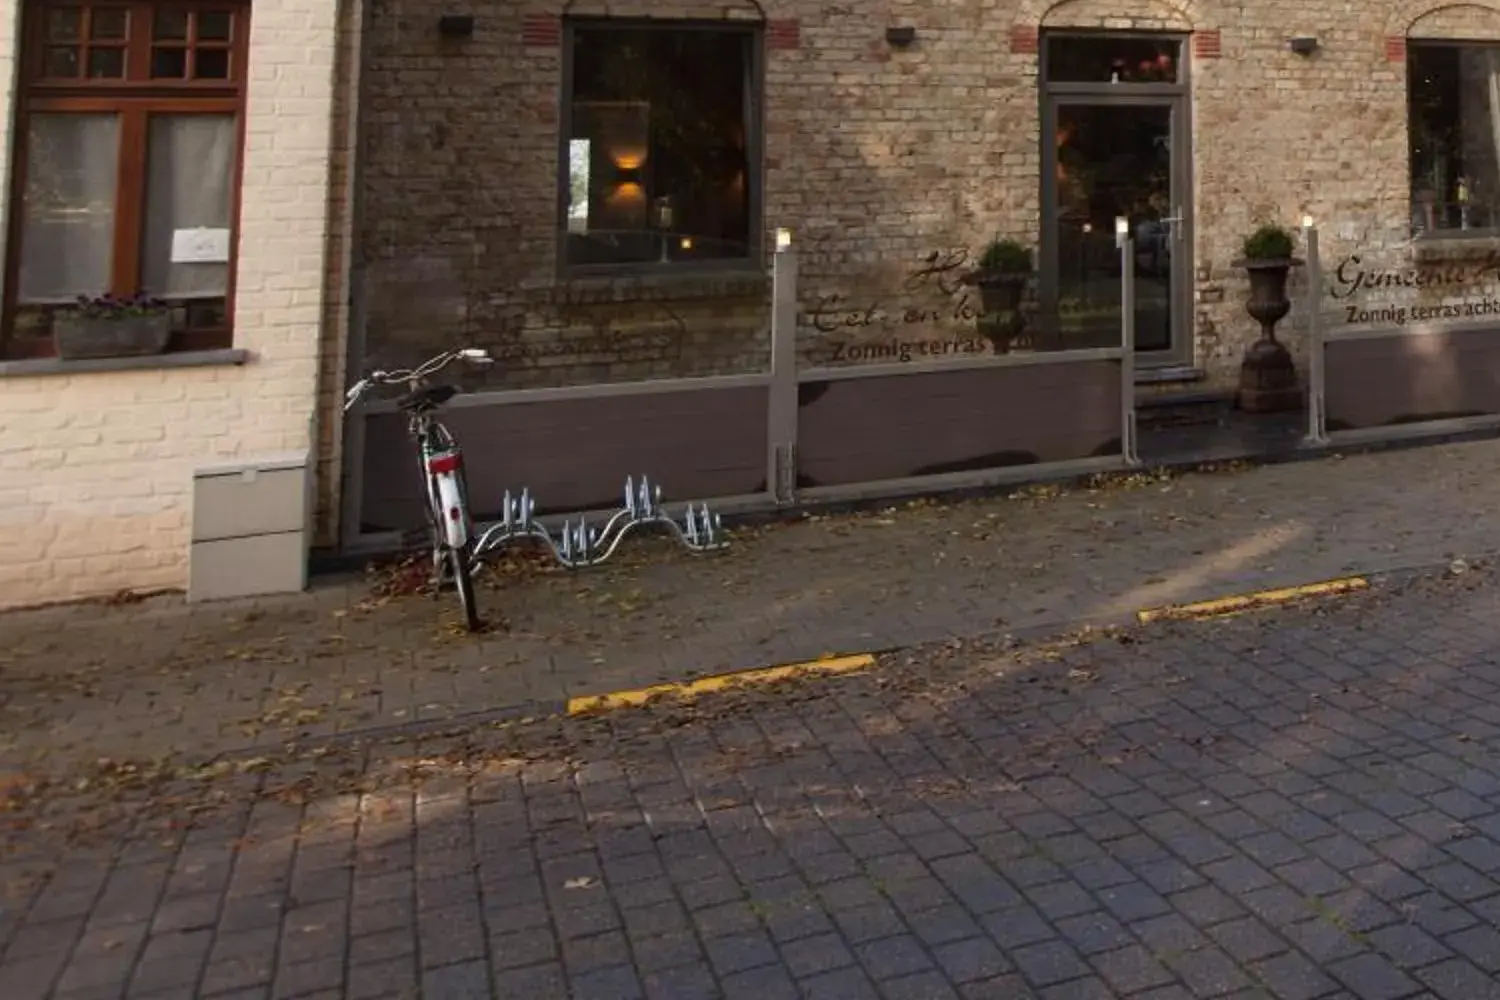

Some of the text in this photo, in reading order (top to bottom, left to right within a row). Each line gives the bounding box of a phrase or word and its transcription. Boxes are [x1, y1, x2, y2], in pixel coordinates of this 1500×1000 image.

[1345, 305, 1405, 324] Zonnig
[1410, 303, 1460, 321] terras
[831, 340, 911, 363] Zonnig
